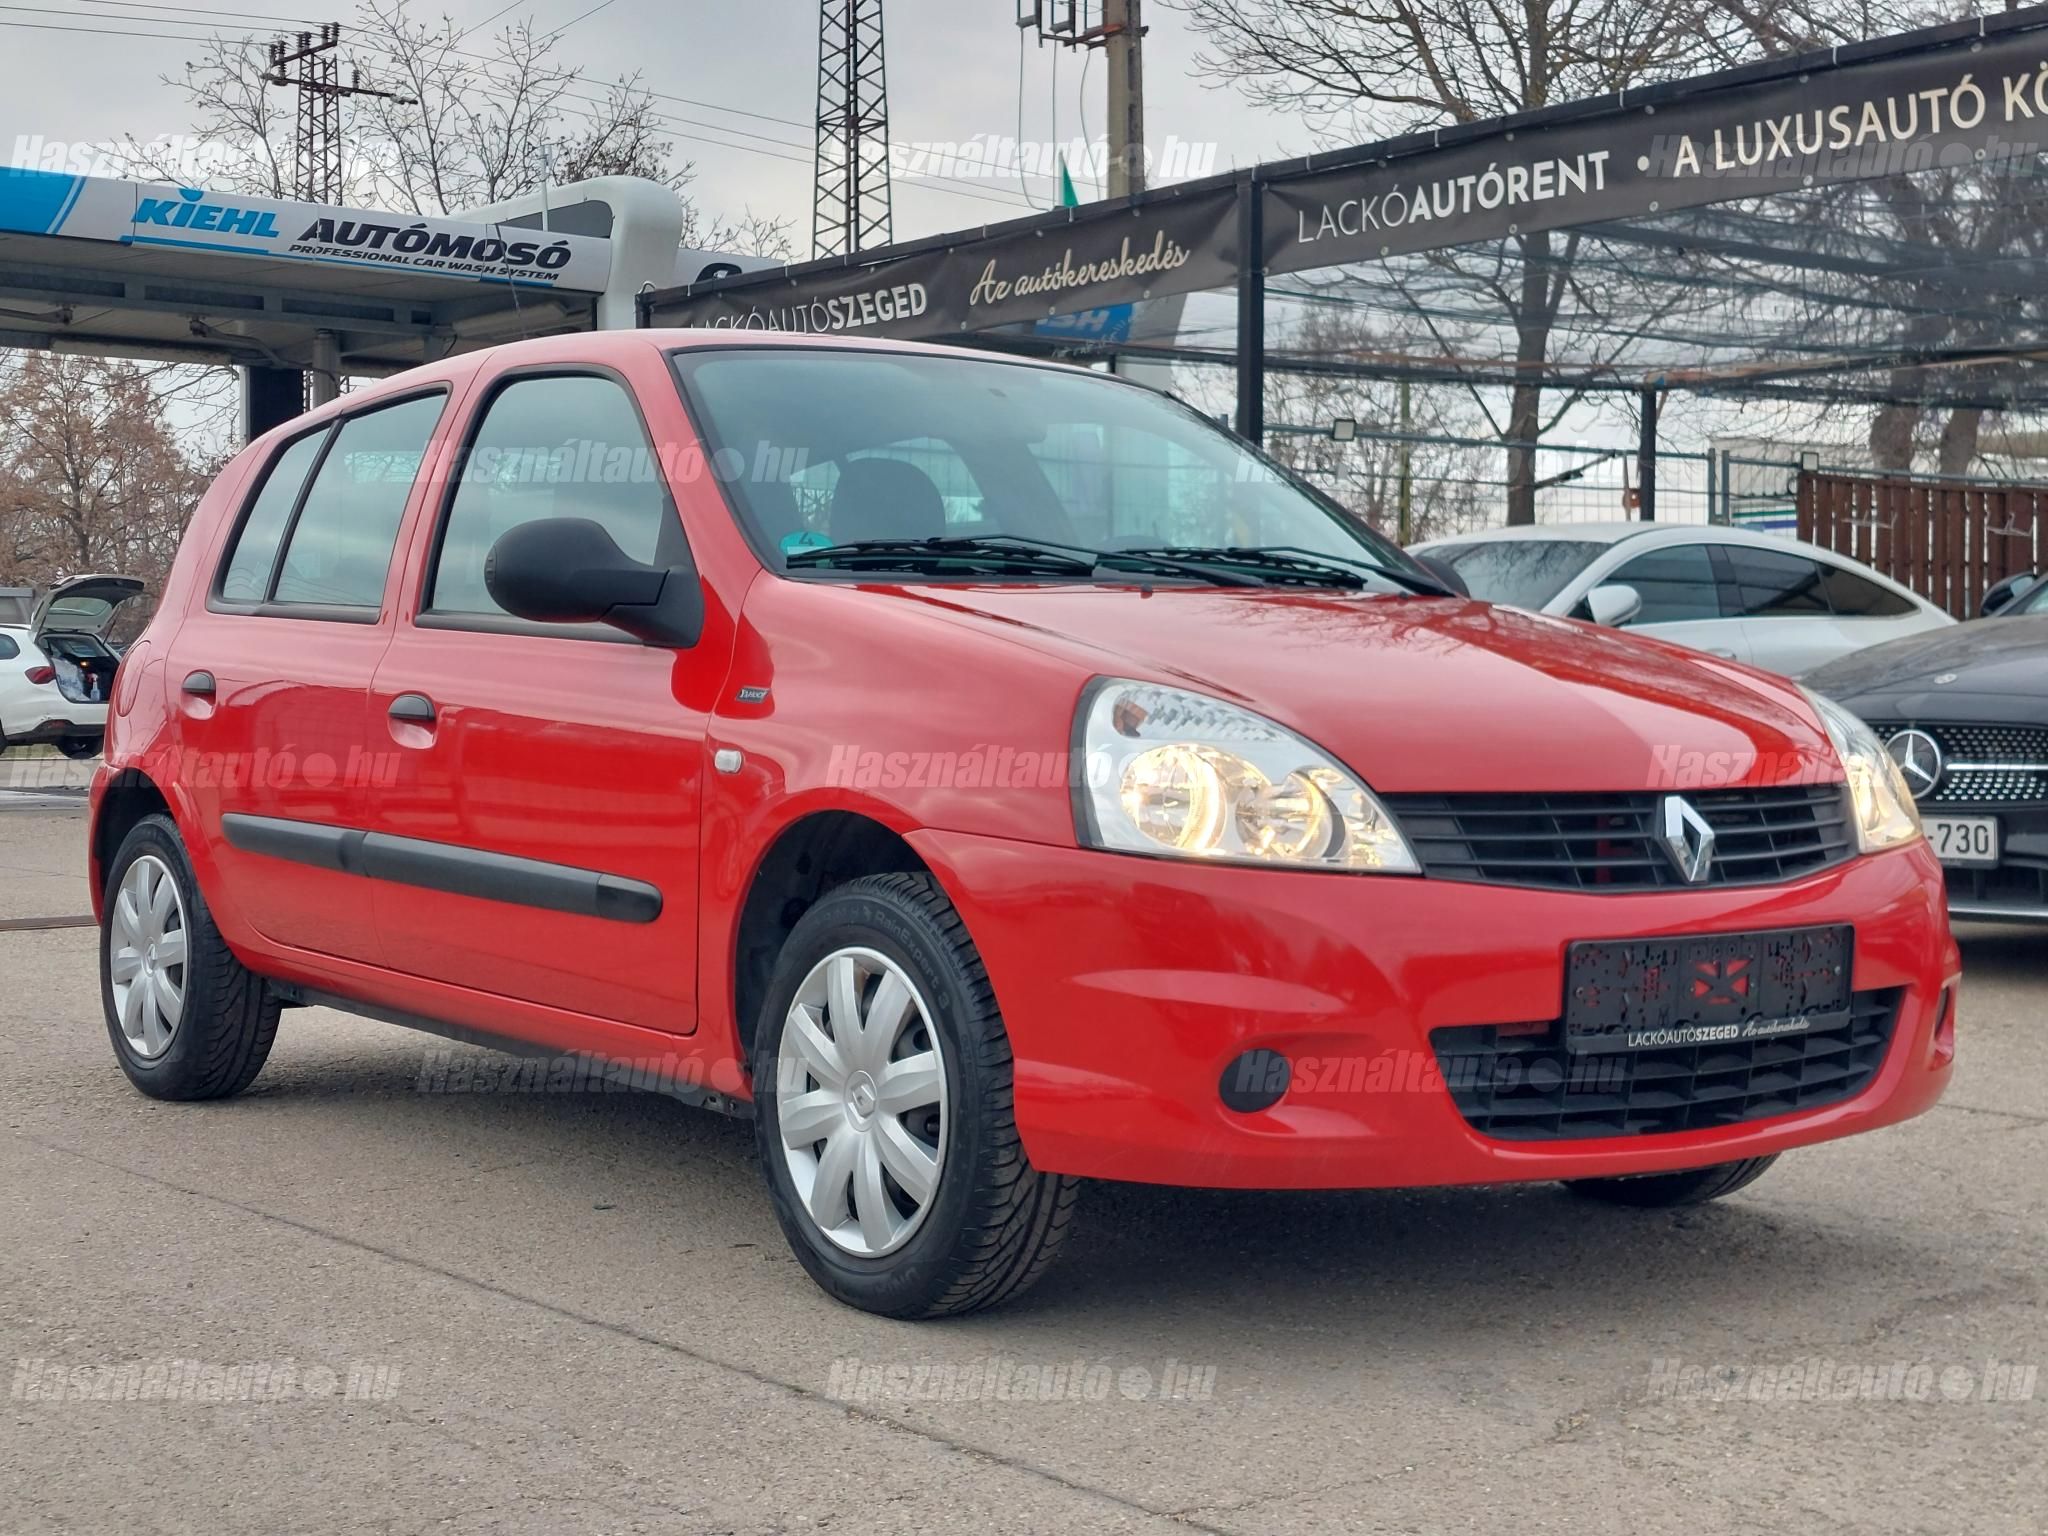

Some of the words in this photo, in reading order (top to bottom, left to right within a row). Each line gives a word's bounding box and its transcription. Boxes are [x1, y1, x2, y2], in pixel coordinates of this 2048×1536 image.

[1298, 150, 1609, 243] LACKÓAUTÓRENT
[1673, 135, 1701, 178] A
[1713, 74, 1985, 171] LUXUSAUTÓ
[131, 197, 280, 238] KIEHL
[288, 244, 410, 265] PROFESSIONAL
[413, 257, 445, 269] CAR
[448, 262, 497, 275] WASH
[497, 266, 559, 281] SYSTEM
[297, 218, 571, 269] AUTÓMOSÓ
[969, 259, 1013, 305] Az
[1014, 230, 1190, 298] autókereskedés
[1628, 1025, 1739, 1047] LACKÓAUTÓSZEGED
